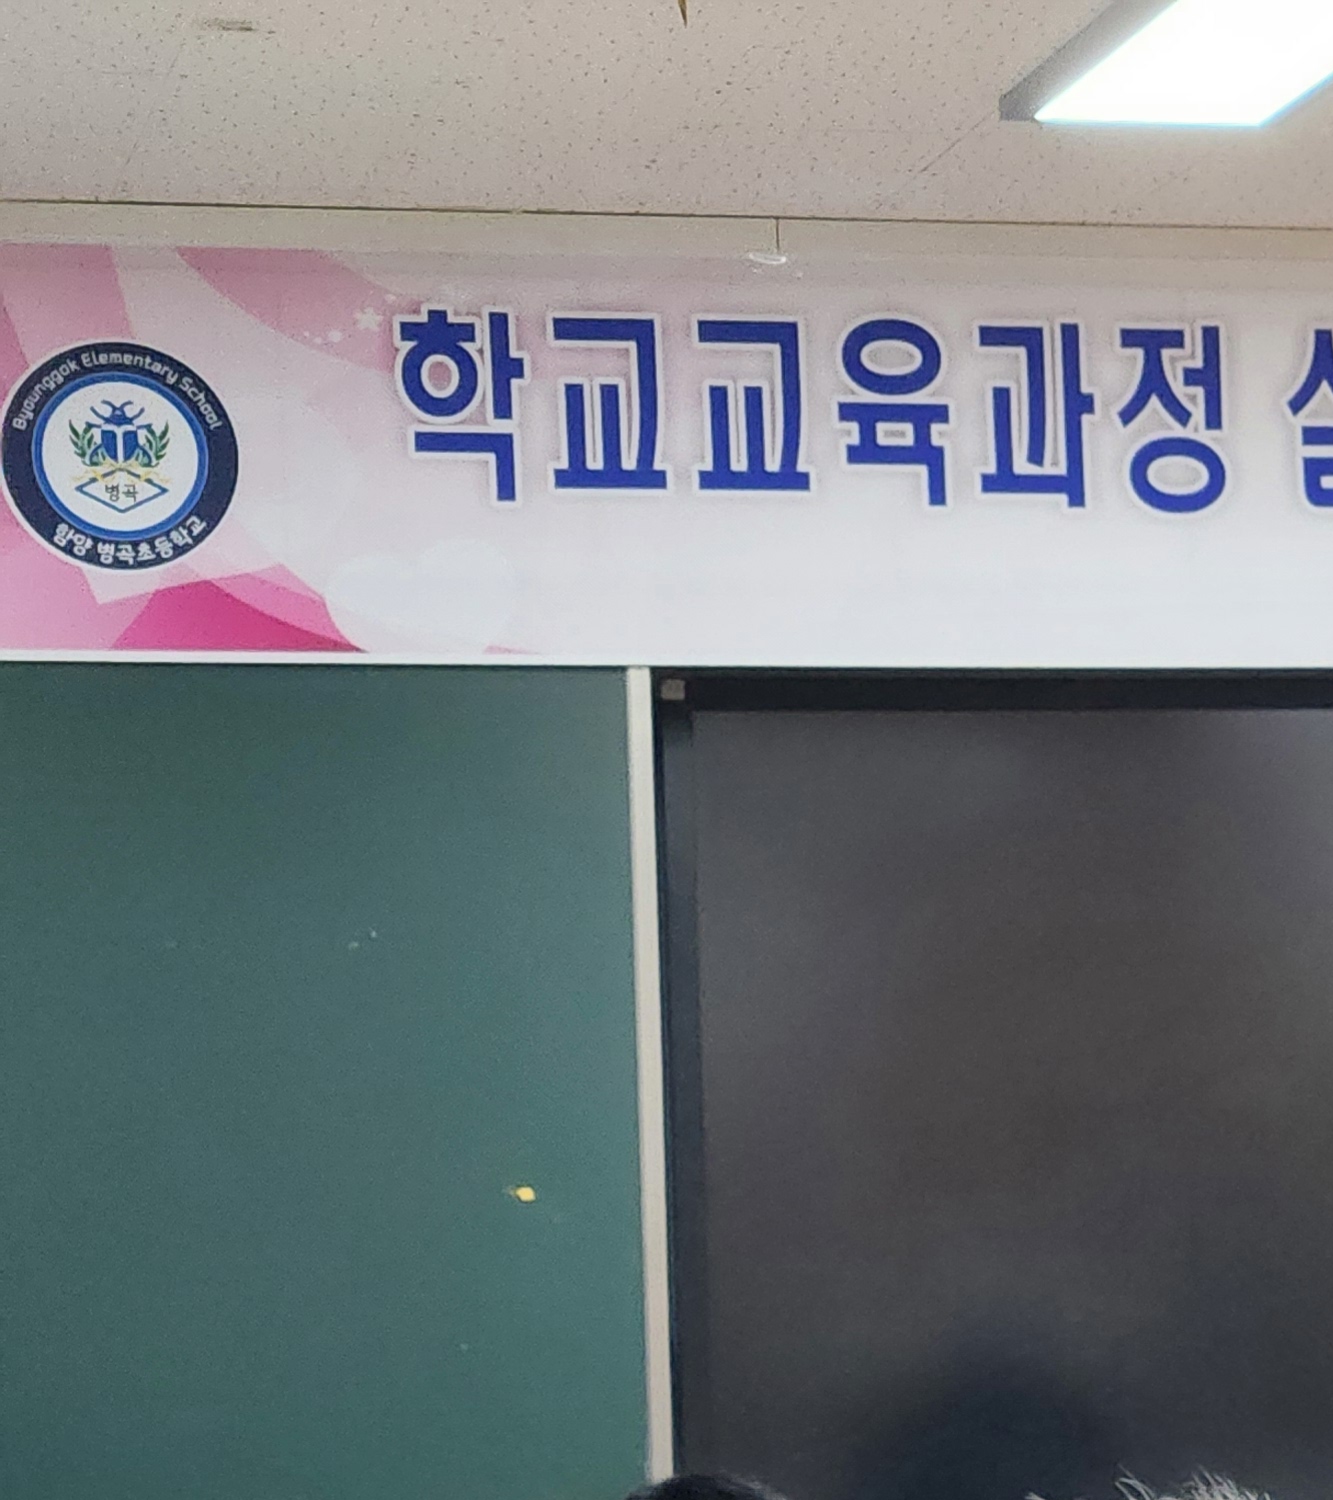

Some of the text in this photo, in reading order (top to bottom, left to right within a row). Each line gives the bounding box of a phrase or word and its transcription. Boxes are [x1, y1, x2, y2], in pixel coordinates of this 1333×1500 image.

[81, 352, 179, 385] Elementary
[179, 377, 223, 430] School
[399, 308, 1227, 513] 학교교육과정
[105, 484, 139, 502] 병곡
[53, 515, 207, 565] 함양 병곡초등학교
